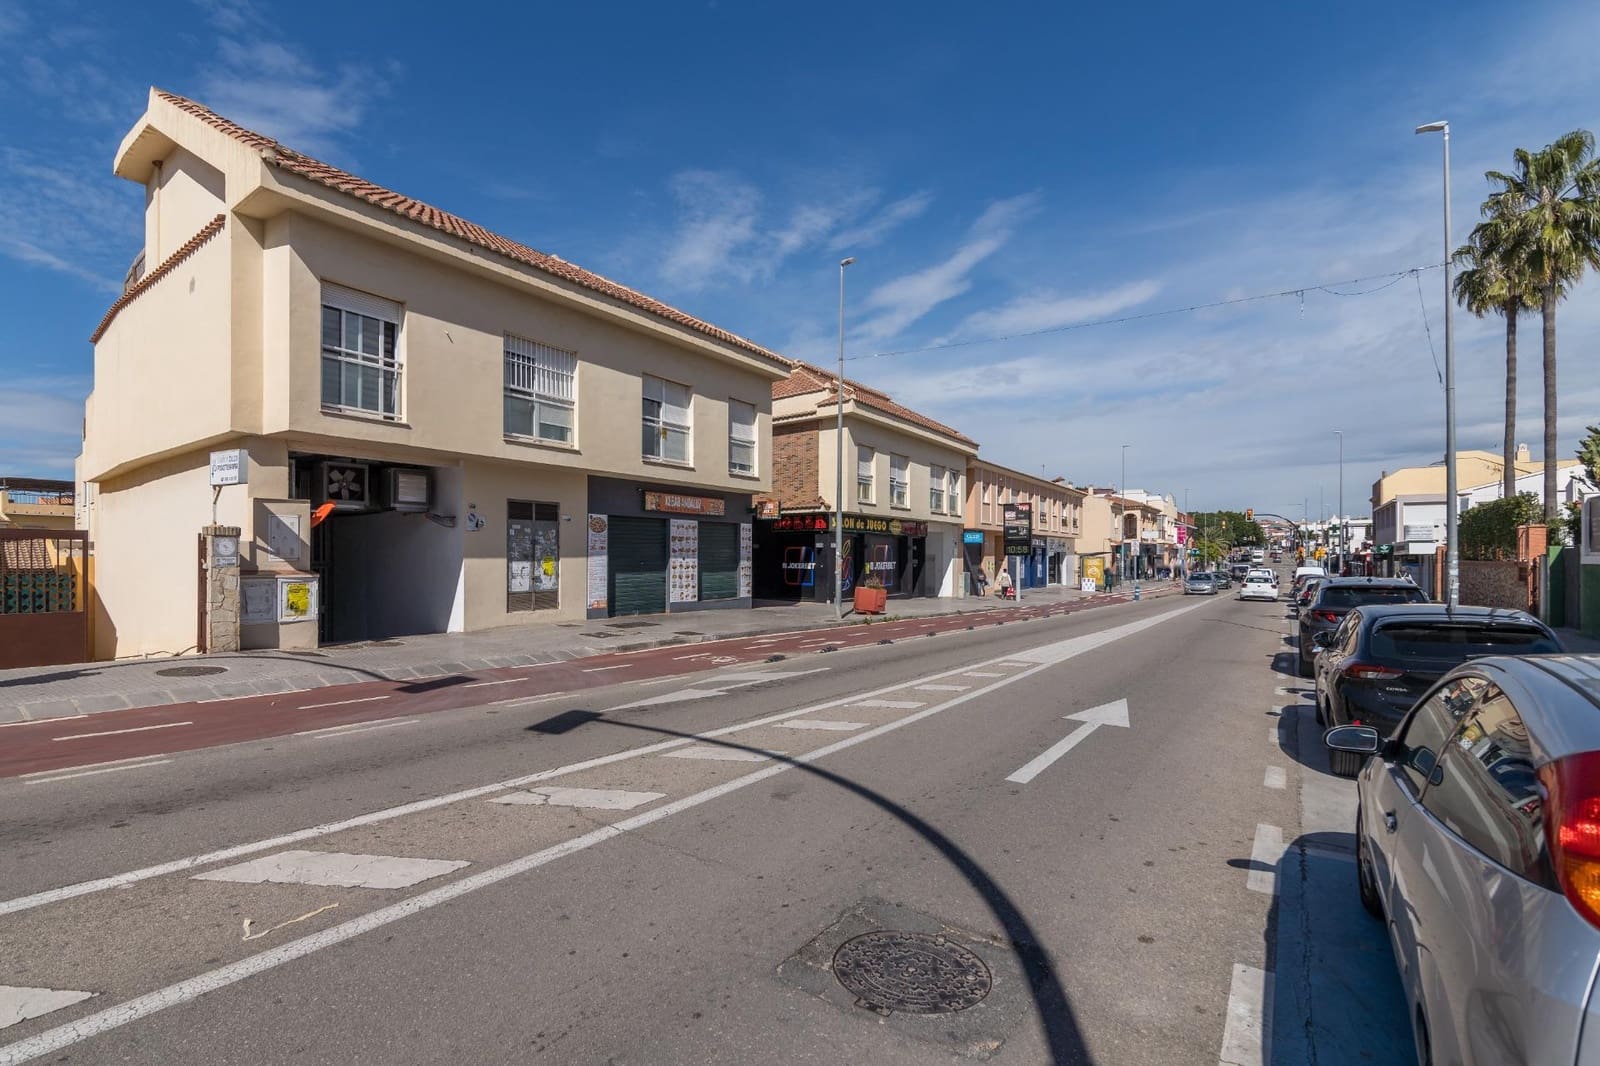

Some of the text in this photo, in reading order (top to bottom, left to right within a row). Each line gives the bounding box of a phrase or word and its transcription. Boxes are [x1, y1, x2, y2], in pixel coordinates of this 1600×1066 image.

[831, 516, 854, 529] SON
[856, 519, 865, 529] de
[866, 519, 887, 530] JUEGO
